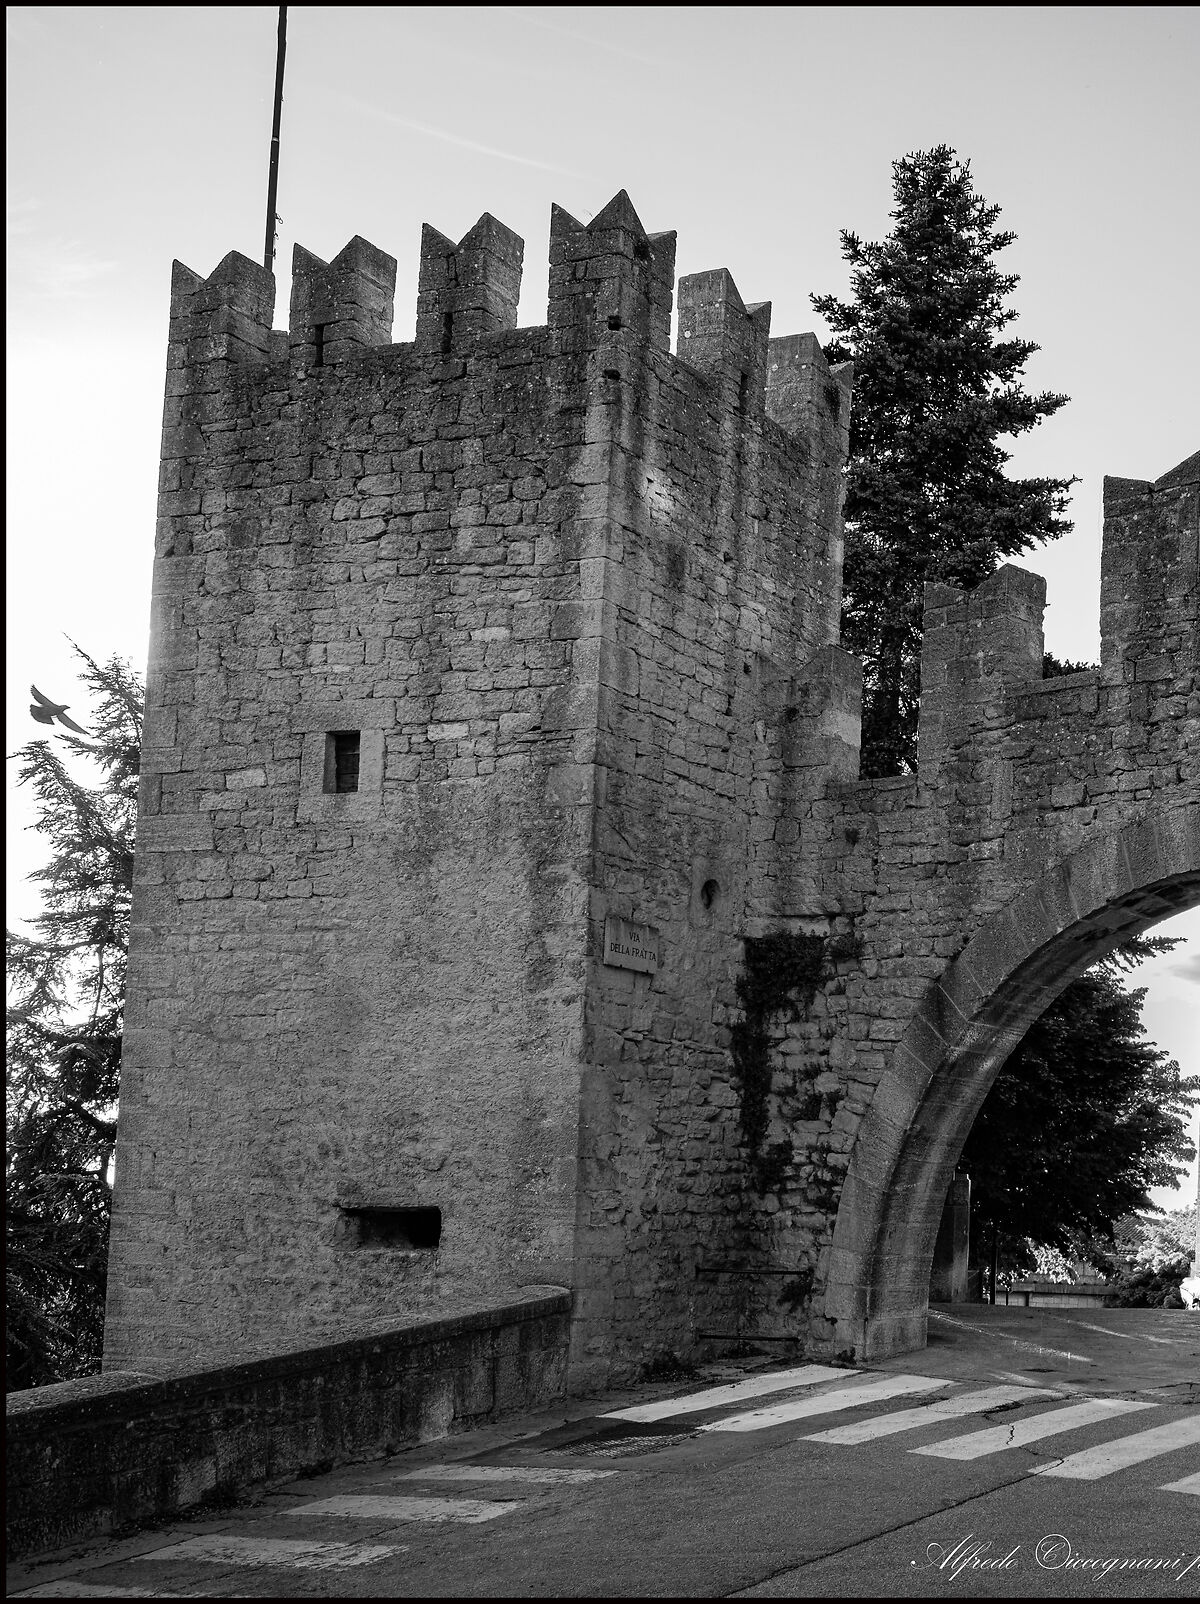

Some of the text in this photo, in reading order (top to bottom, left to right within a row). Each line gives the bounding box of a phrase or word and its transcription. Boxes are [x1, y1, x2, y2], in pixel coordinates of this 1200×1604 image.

[629, 932, 641, 942] VIA
[610, 943, 657, 961] DELLA FRATTA
